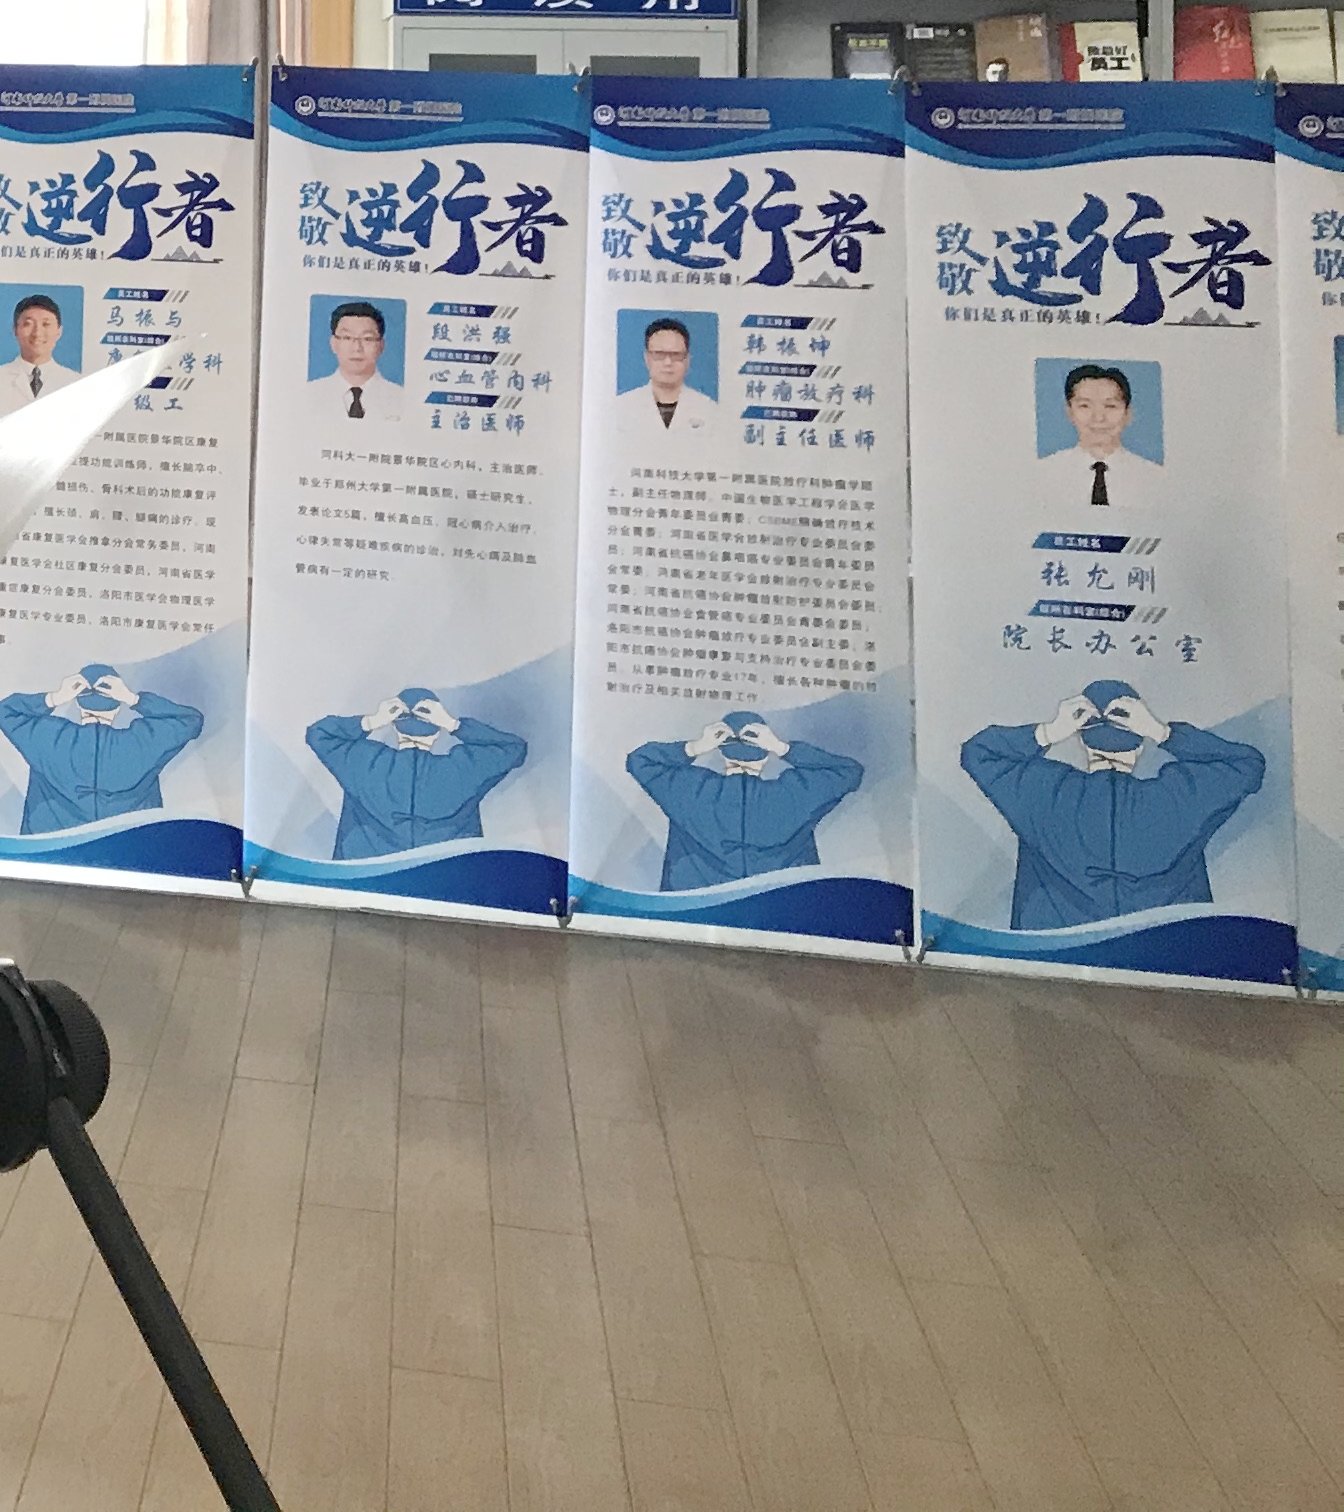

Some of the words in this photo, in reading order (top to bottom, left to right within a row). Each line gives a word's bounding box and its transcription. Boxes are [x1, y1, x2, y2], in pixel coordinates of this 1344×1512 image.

[21, 149, 236, 261] 逆行者
[340, 159, 570, 276] 逆行者
[644, 168, 886, 288] 逆行者
[986, 192, 1273, 326] 逆行者
[431, 322, 513, 345] 段洪强
[429, 368, 553, 394] 心血管内科
[745, 379, 876, 406] 肿瘤放疗科
[430, 408, 525, 437] 主治医师
[743, 423, 876, 454] 副主任医师
[1001, 623, 1203, 664] 院长办公室
